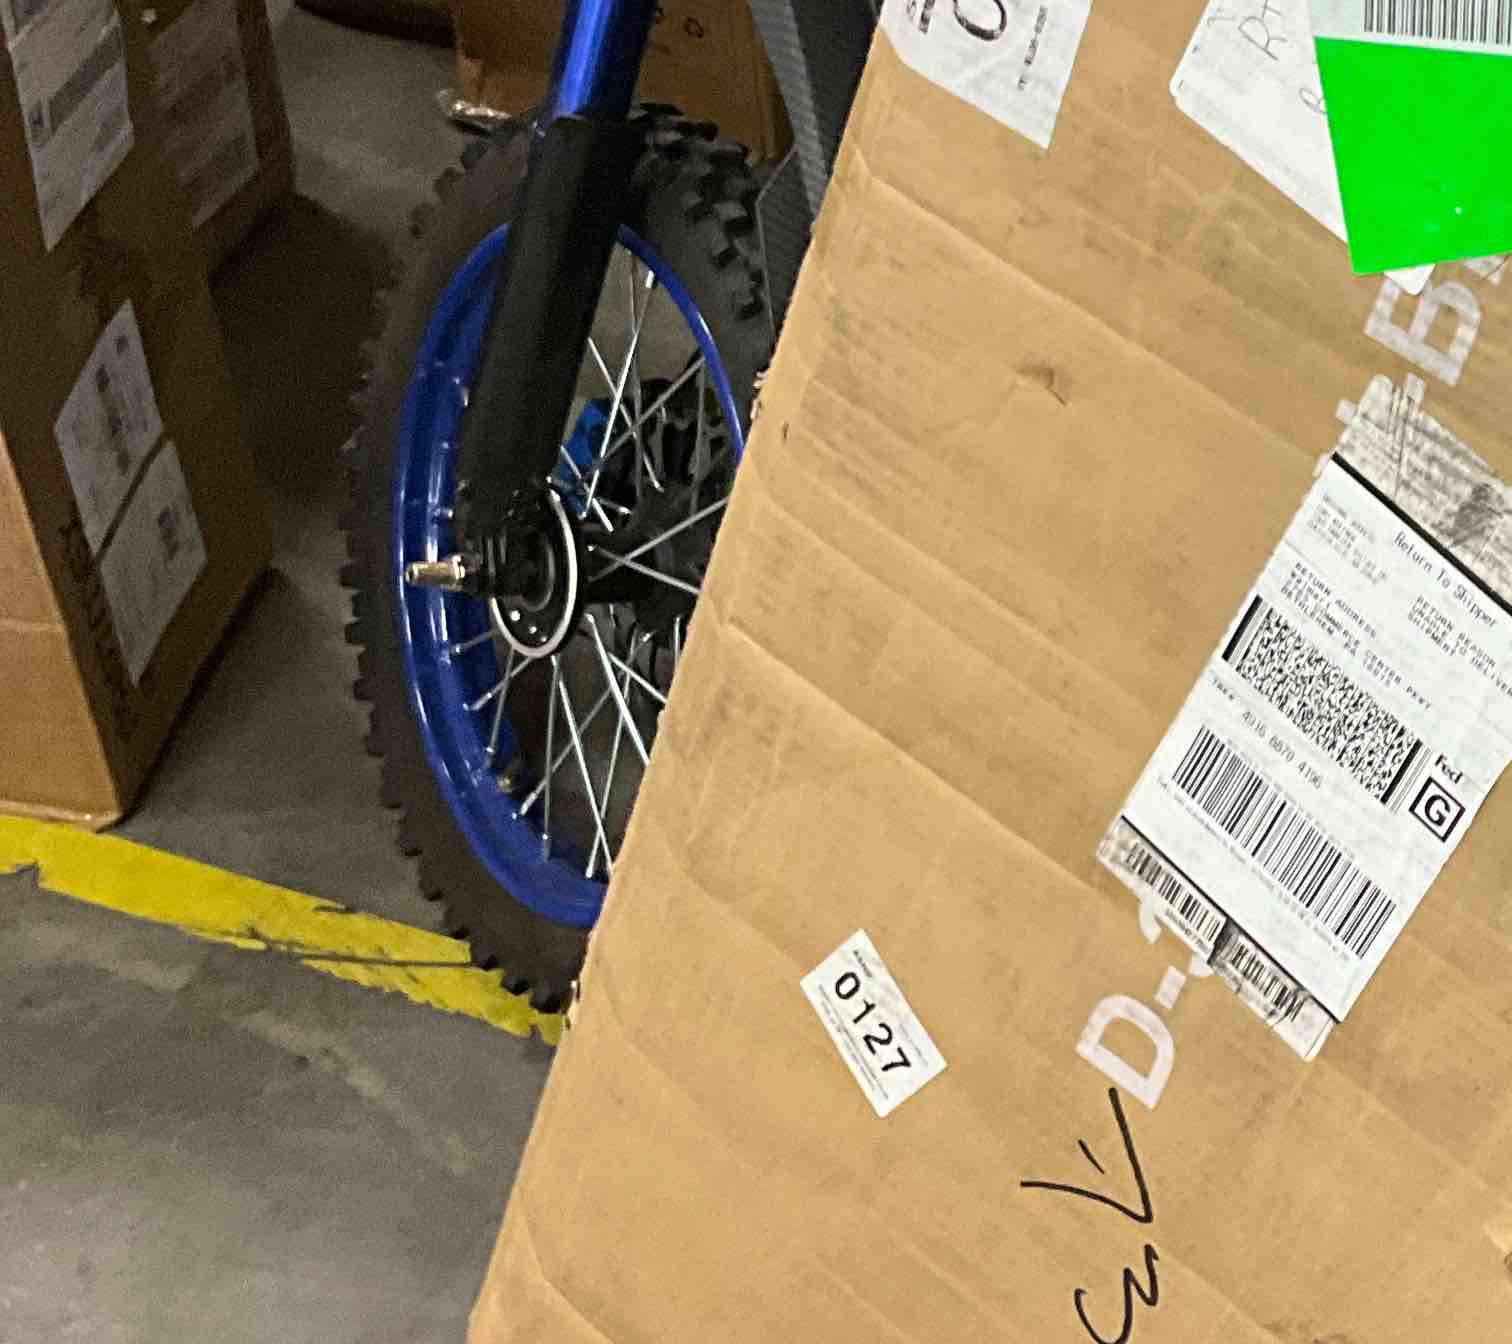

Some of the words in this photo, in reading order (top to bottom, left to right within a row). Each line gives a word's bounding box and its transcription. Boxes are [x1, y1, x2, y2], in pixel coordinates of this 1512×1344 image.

[1294, 560, 1332, 597] RETURN
[1334, 597, 1378, 640] ADDRESS
[1393, 530, 1433, 573] Return
[1454, 583, 1497, 628] Shipper
[1407, 611, 1457, 657] SHIPMENT
[1411, 603, 1449, 645] UNABLE
[1416, 594, 1454, 632] RETURN
[1457, 631, 1497, 668] REASON
[1364, 648, 1403, 687] CENTER
[1424, 793, 1452, 828] G
[834, 972, 912, 1072] 0127
